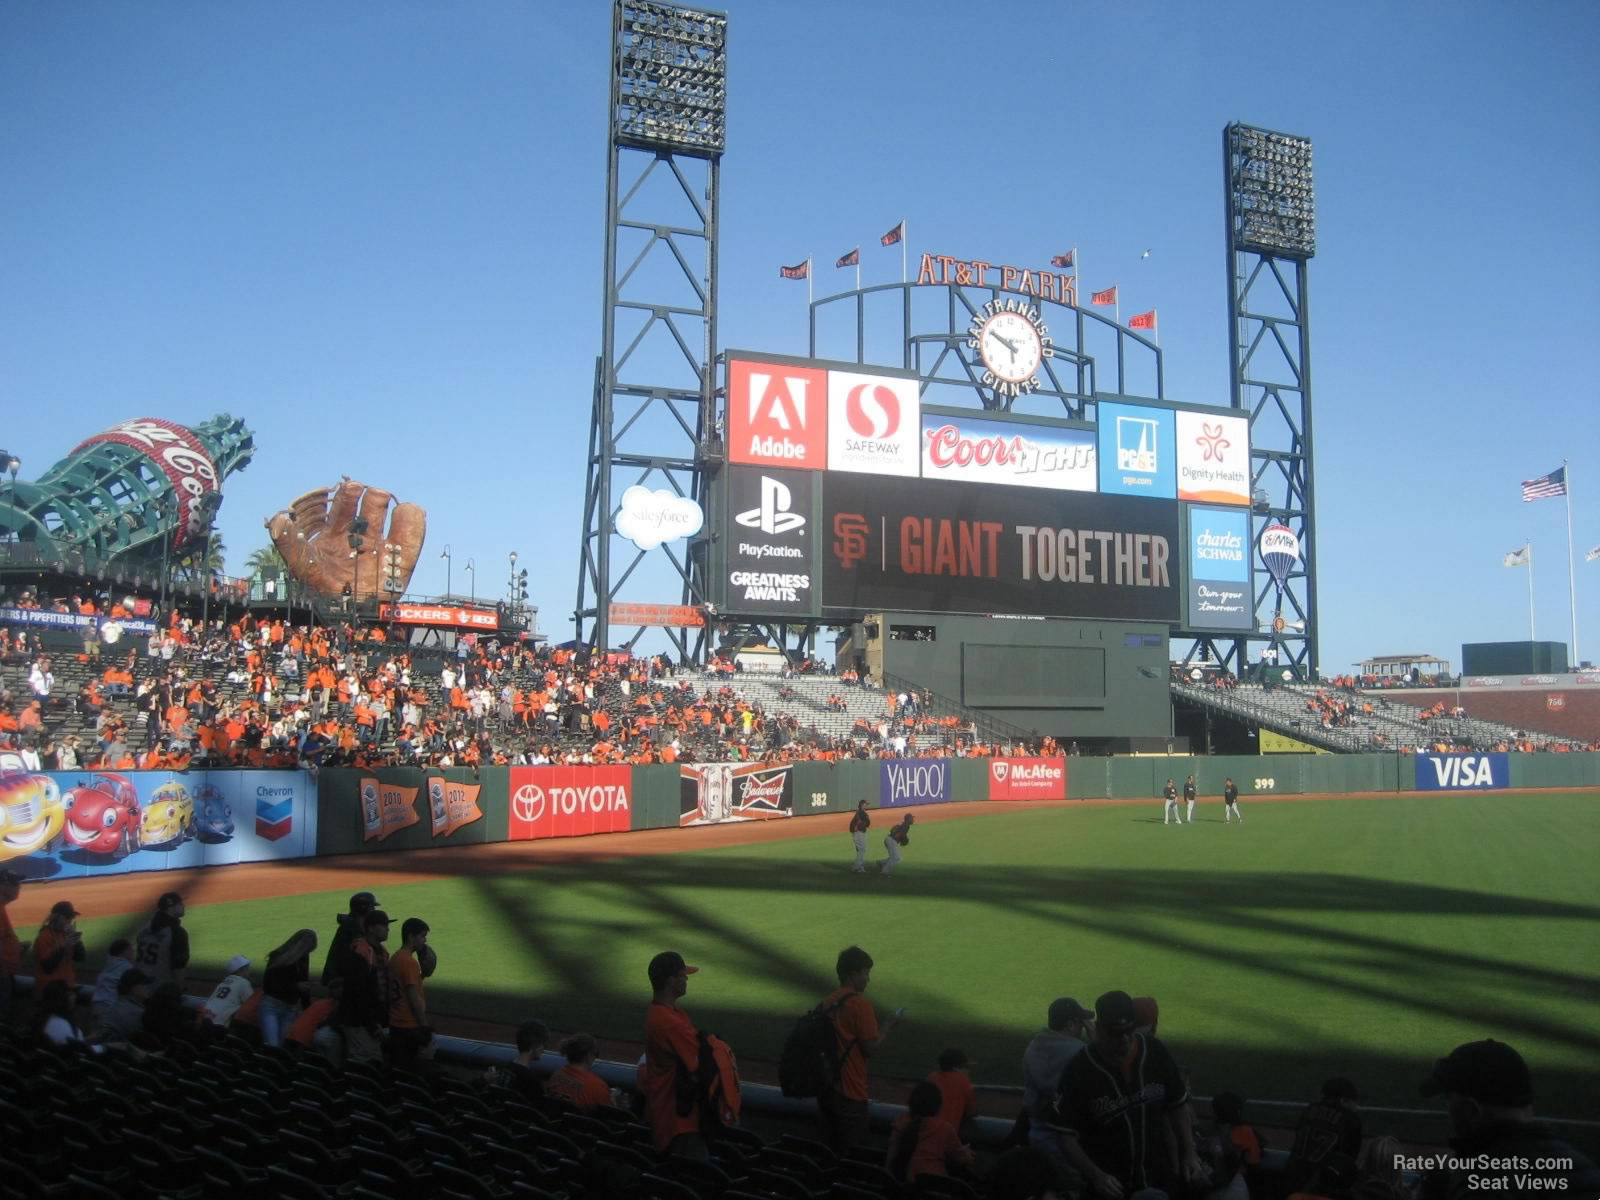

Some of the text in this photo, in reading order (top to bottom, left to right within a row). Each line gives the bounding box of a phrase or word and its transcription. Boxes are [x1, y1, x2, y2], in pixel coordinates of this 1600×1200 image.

[916, 253, 1078, 307] AT&T PARK
[968, 299, 1055, 359] SAN FRANCISCO
[982, 371, 1041, 396] GIANTS
[750, 435, 806, 460] Adobe
[845, 440, 901, 455] SAFEWAY
[926, 425, 1094, 474] Coors LIGHT
[1118, 447, 1157, 473] PG&E
[1182, 467, 1245, 482] Dignity Health
[632, 507, 689, 528] salesforce
[1197, 529, 1242, 547] charles
[1265, 533, 1294, 548] RE/MAX
[739, 543, 802, 559] PlayStation
[900, 516, 1171, 587] GIANT TOGETHER
[1197, 548, 1243, 561] SCHWAB
[730, 571, 810, 589] GREATNESS
[1198, 585, 1243, 604] Own your
[30, 611, 74, 625] PIPEFITTERS
[384, 608, 450, 621] DOCKERS
[1547, 698, 1562, 706] 756
[1011, 764, 1061, 781] McAfee
[1429, 757, 1493, 786] VISA
[256, 786, 293, 797] Chevron
[740, 782, 784, 799] Budweiser
[887, 763, 945, 803] YAHOO!
[1255, 779, 1275, 789] 399
[384, 792, 402, 807] 2010
[448, 790, 465, 804] 2012
[549, 785, 628, 815] TOYOTA
[811, 792, 827, 807] 382
